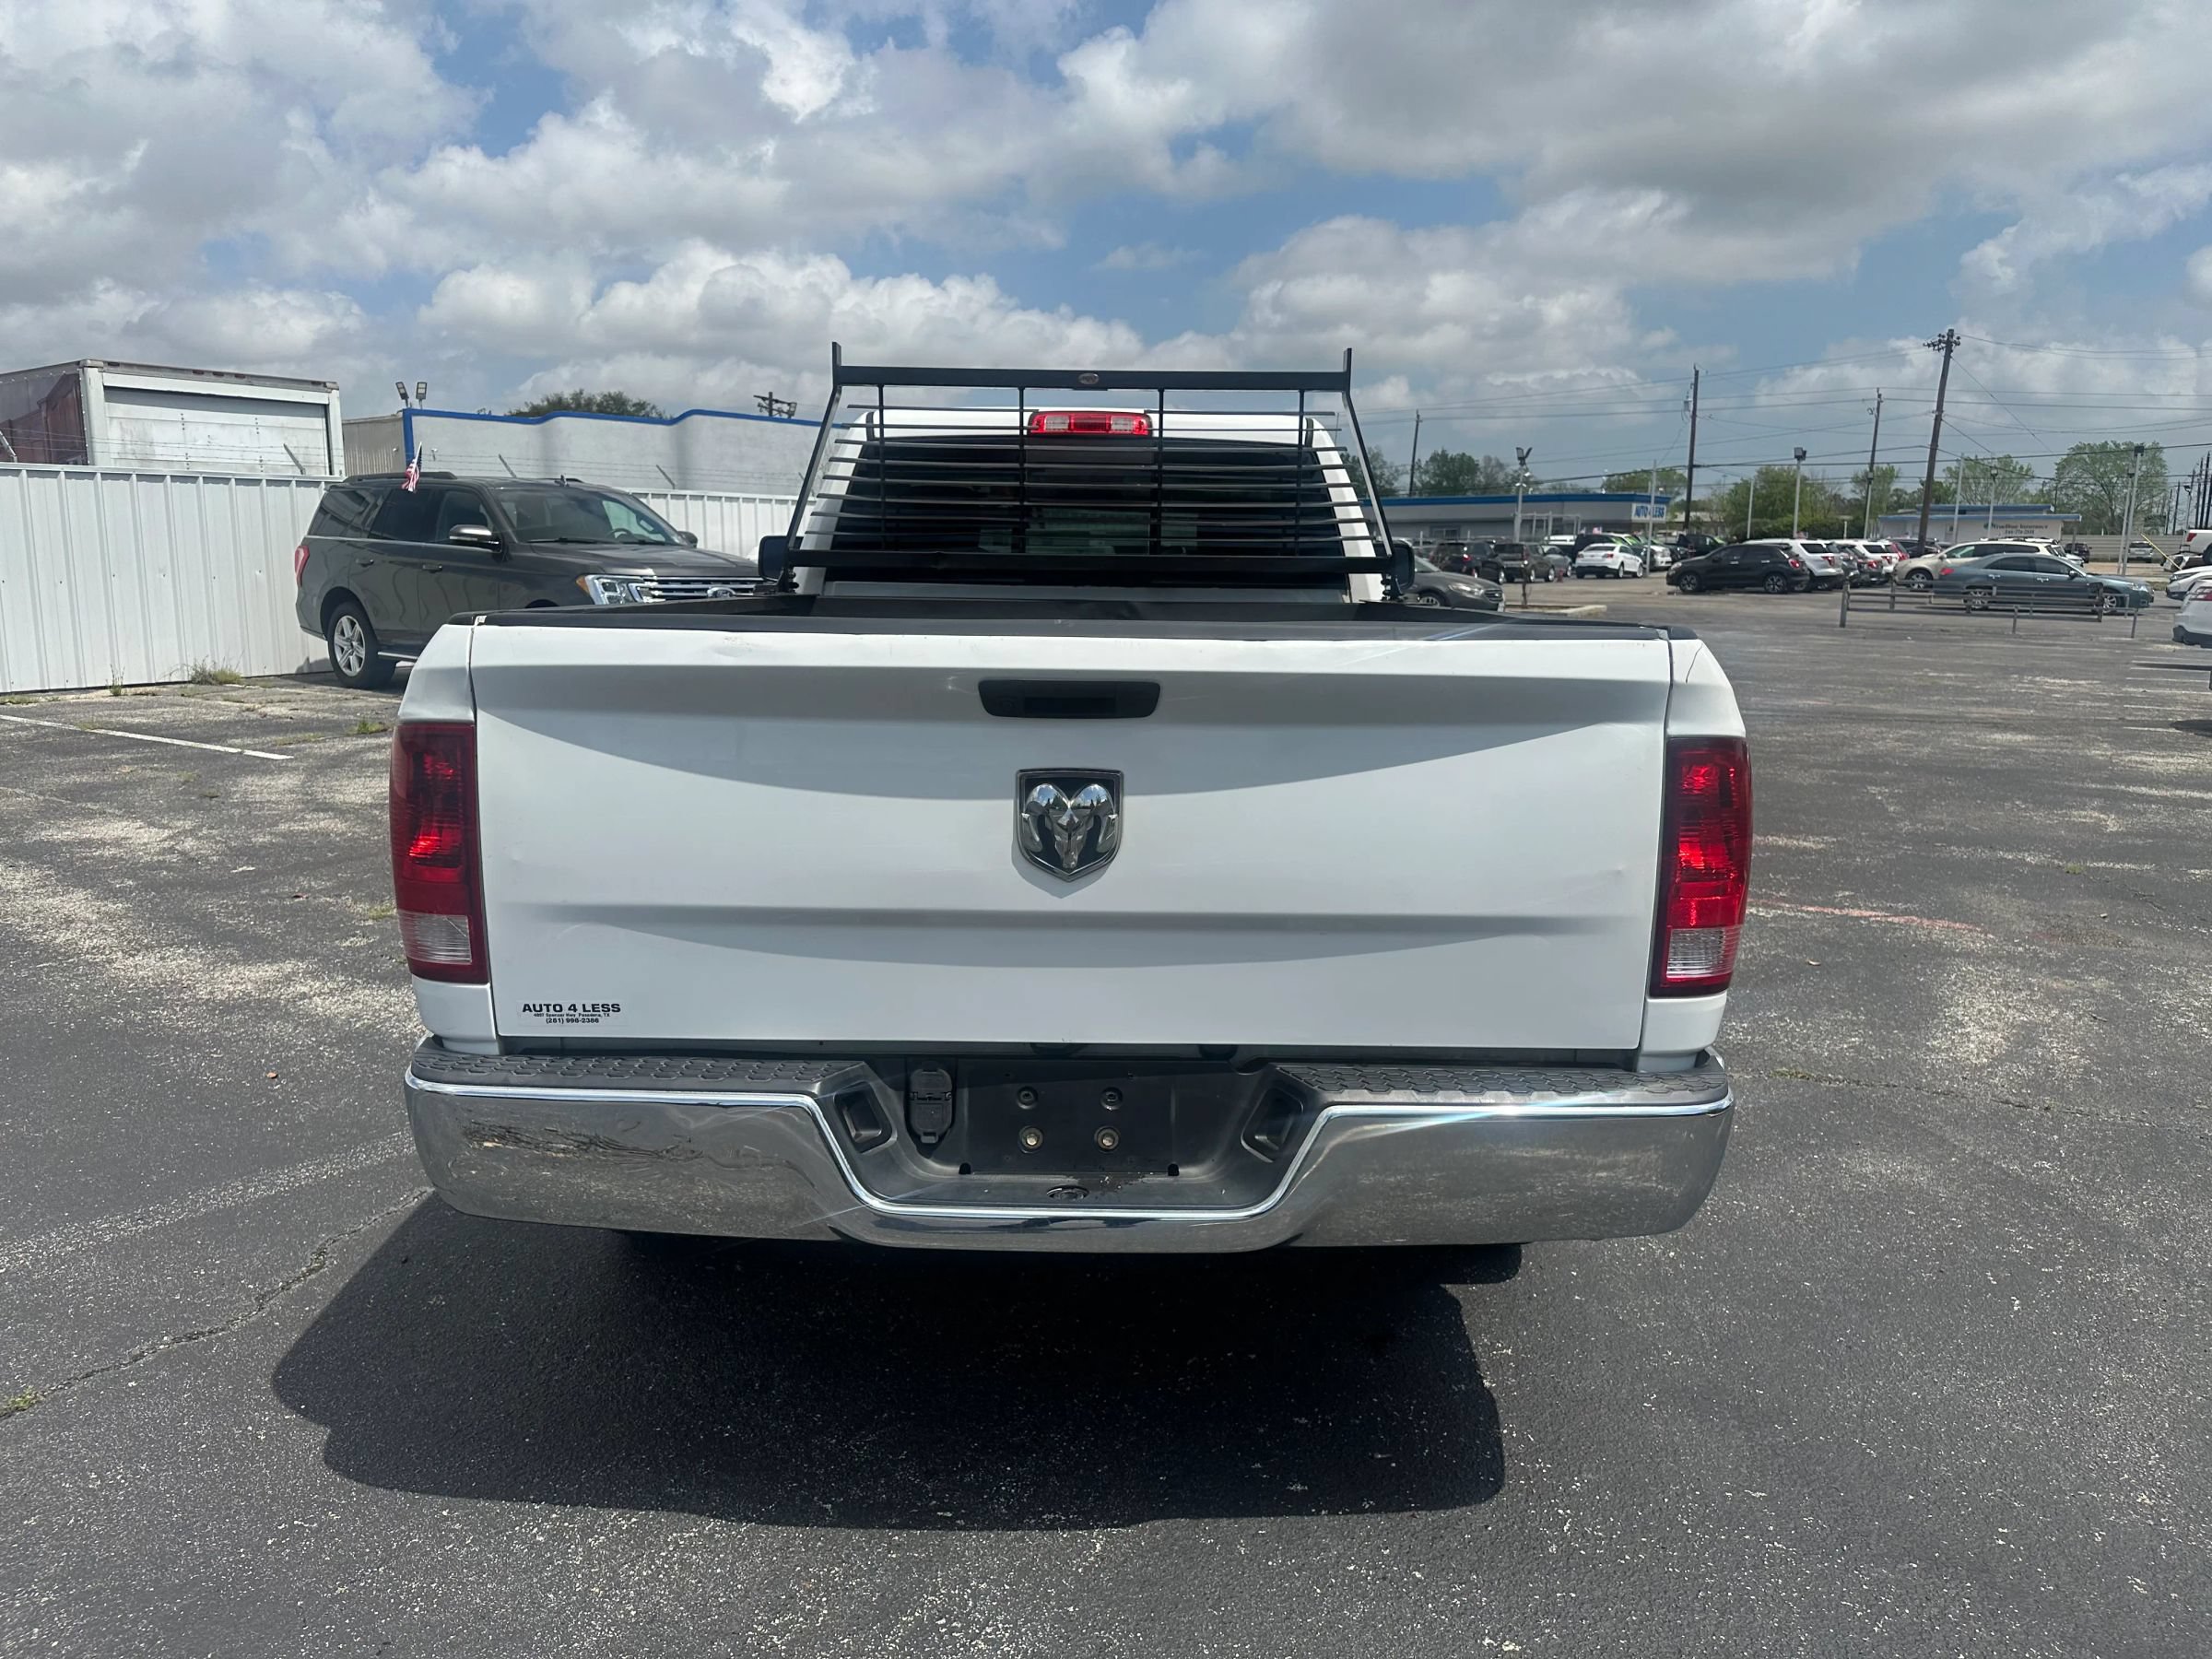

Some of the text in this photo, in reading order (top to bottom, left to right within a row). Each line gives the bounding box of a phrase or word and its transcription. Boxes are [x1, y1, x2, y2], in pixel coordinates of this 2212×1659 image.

[522, 1003, 621, 1013] AUTO 4 LESS
